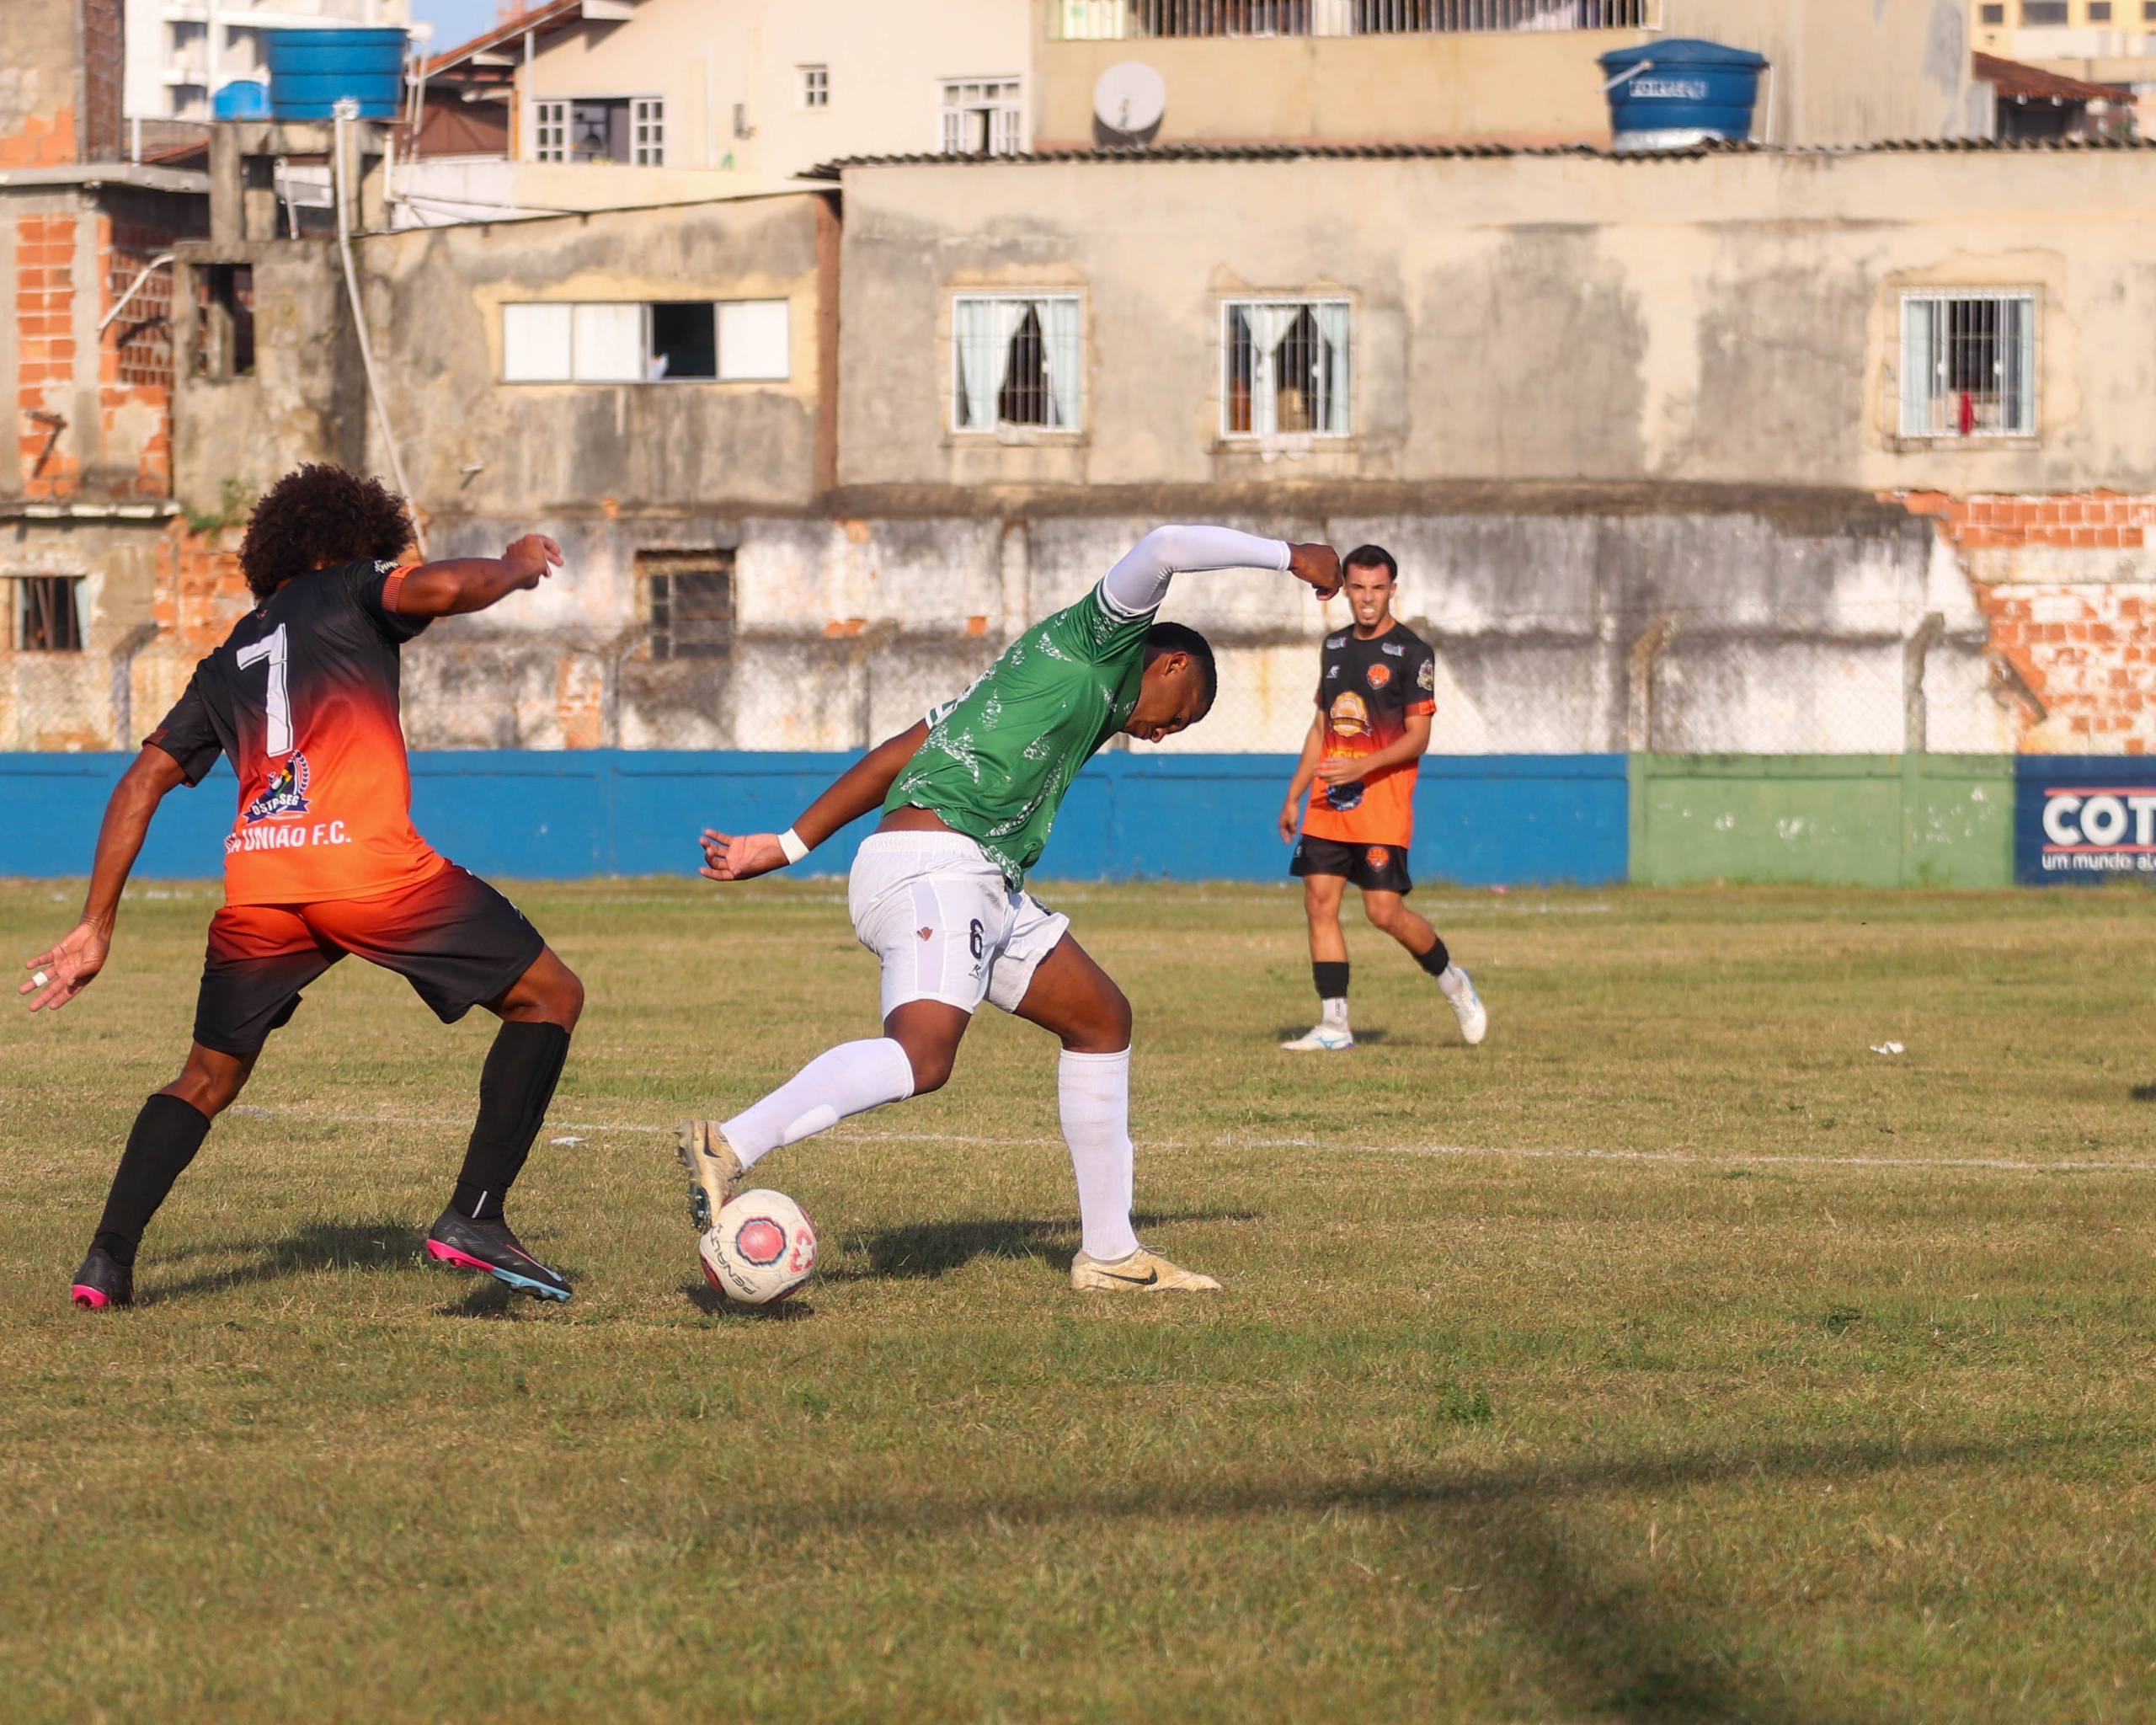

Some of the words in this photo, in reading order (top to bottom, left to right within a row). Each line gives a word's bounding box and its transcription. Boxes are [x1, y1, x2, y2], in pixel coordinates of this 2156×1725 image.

[237, 622, 293, 757] 7
[242, 825, 307, 852] UNIÃO
[312, 820, 352, 846] F.C.
[2041, 852, 2069, 871] um
[2073, 851, 2132, 871] mundo
[2137, 851, 2156, 871] al
[969, 918, 985, 960] 6
